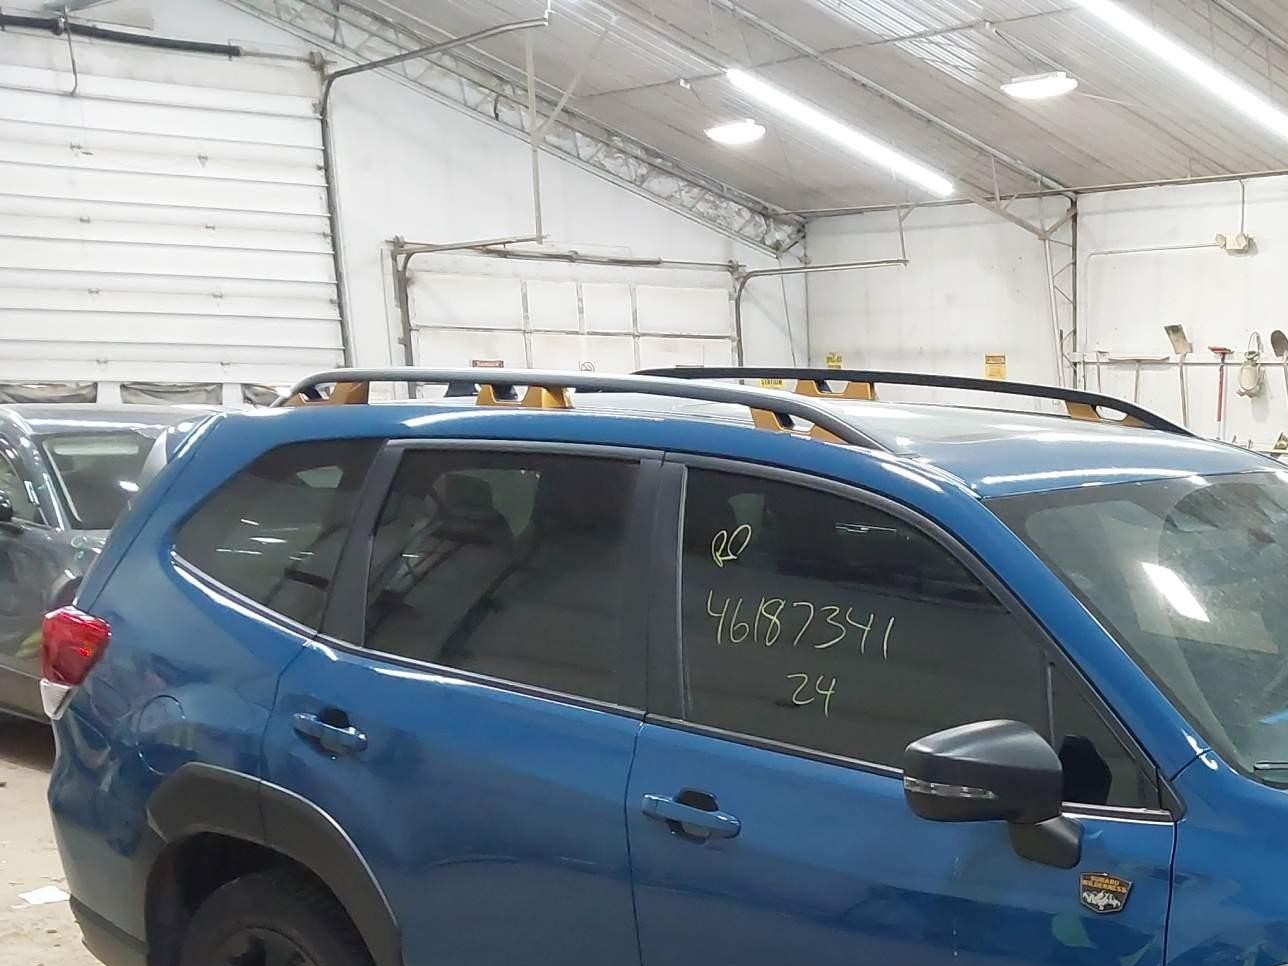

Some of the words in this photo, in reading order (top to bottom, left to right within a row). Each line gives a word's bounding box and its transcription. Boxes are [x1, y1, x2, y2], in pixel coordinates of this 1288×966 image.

[706, 589, 895, 660] 46187341
[786, 672, 837, 719] 24
[1090, 875, 1120, 886] SUBARU
